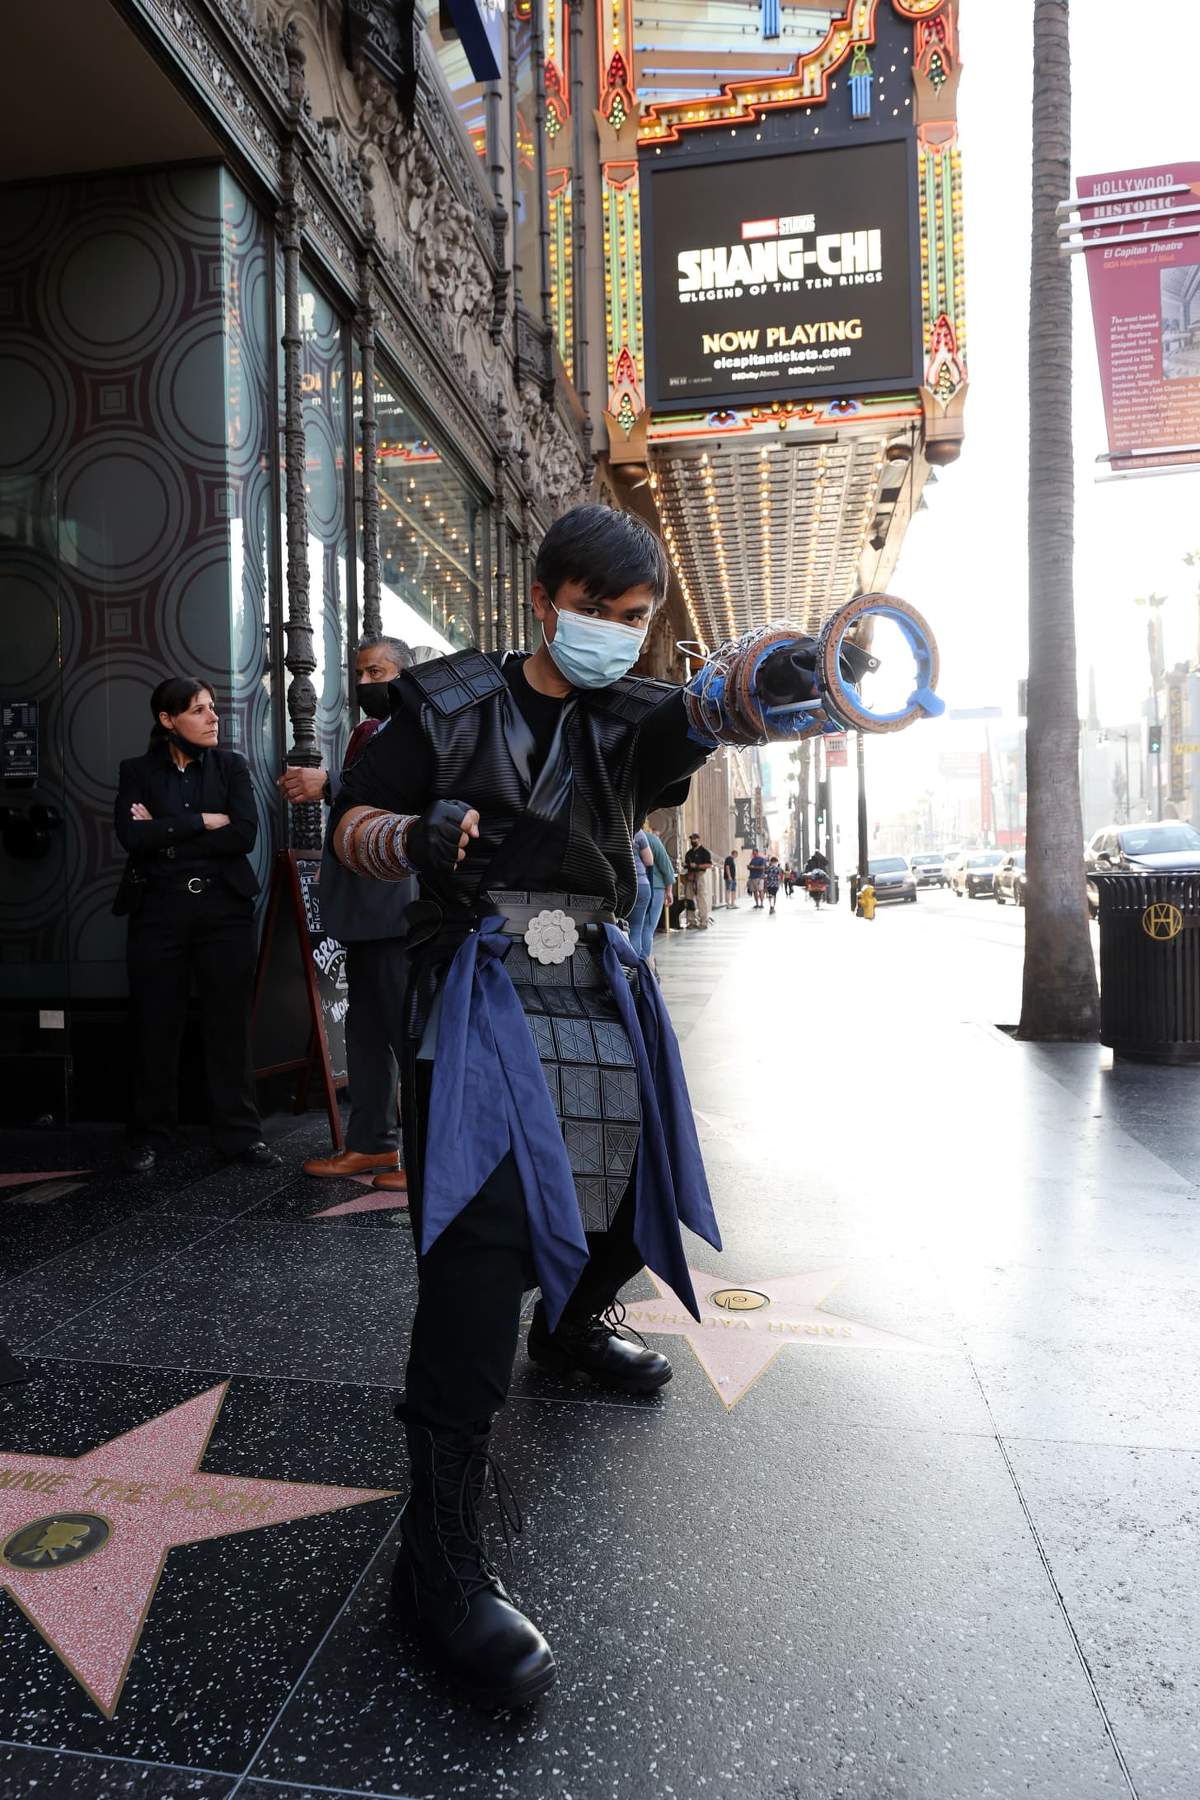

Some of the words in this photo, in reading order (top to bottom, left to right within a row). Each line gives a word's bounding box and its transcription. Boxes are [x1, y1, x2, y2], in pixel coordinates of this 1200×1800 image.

[1093, 174, 1174, 196] HOLLYWOOD
[1094, 196, 1175, 217] HISTORIC
[678, 229, 882, 292] SHANG-CHI
[1104, 249, 1113, 258] El
[1114, 245, 1148, 258] Capitan
[1150, 242, 1184, 253] Theatre
[691, 287, 743, 302] LEGEND
[749, 284, 768, 296] OF
[773, 281, 800, 293] THE
[805, 277, 833, 289] TEN
[839, 272, 883, 286] RINGS
[702, 330, 759, 354] NOW
[767, 319, 863, 347] PLAYING
[714, 347, 851, 369] elcapitantickets.com
[766, 1319, 854, 1338] SARAH
[83, 1477, 158, 1504] THE
[163, 1487, 275, 1516] POOH
